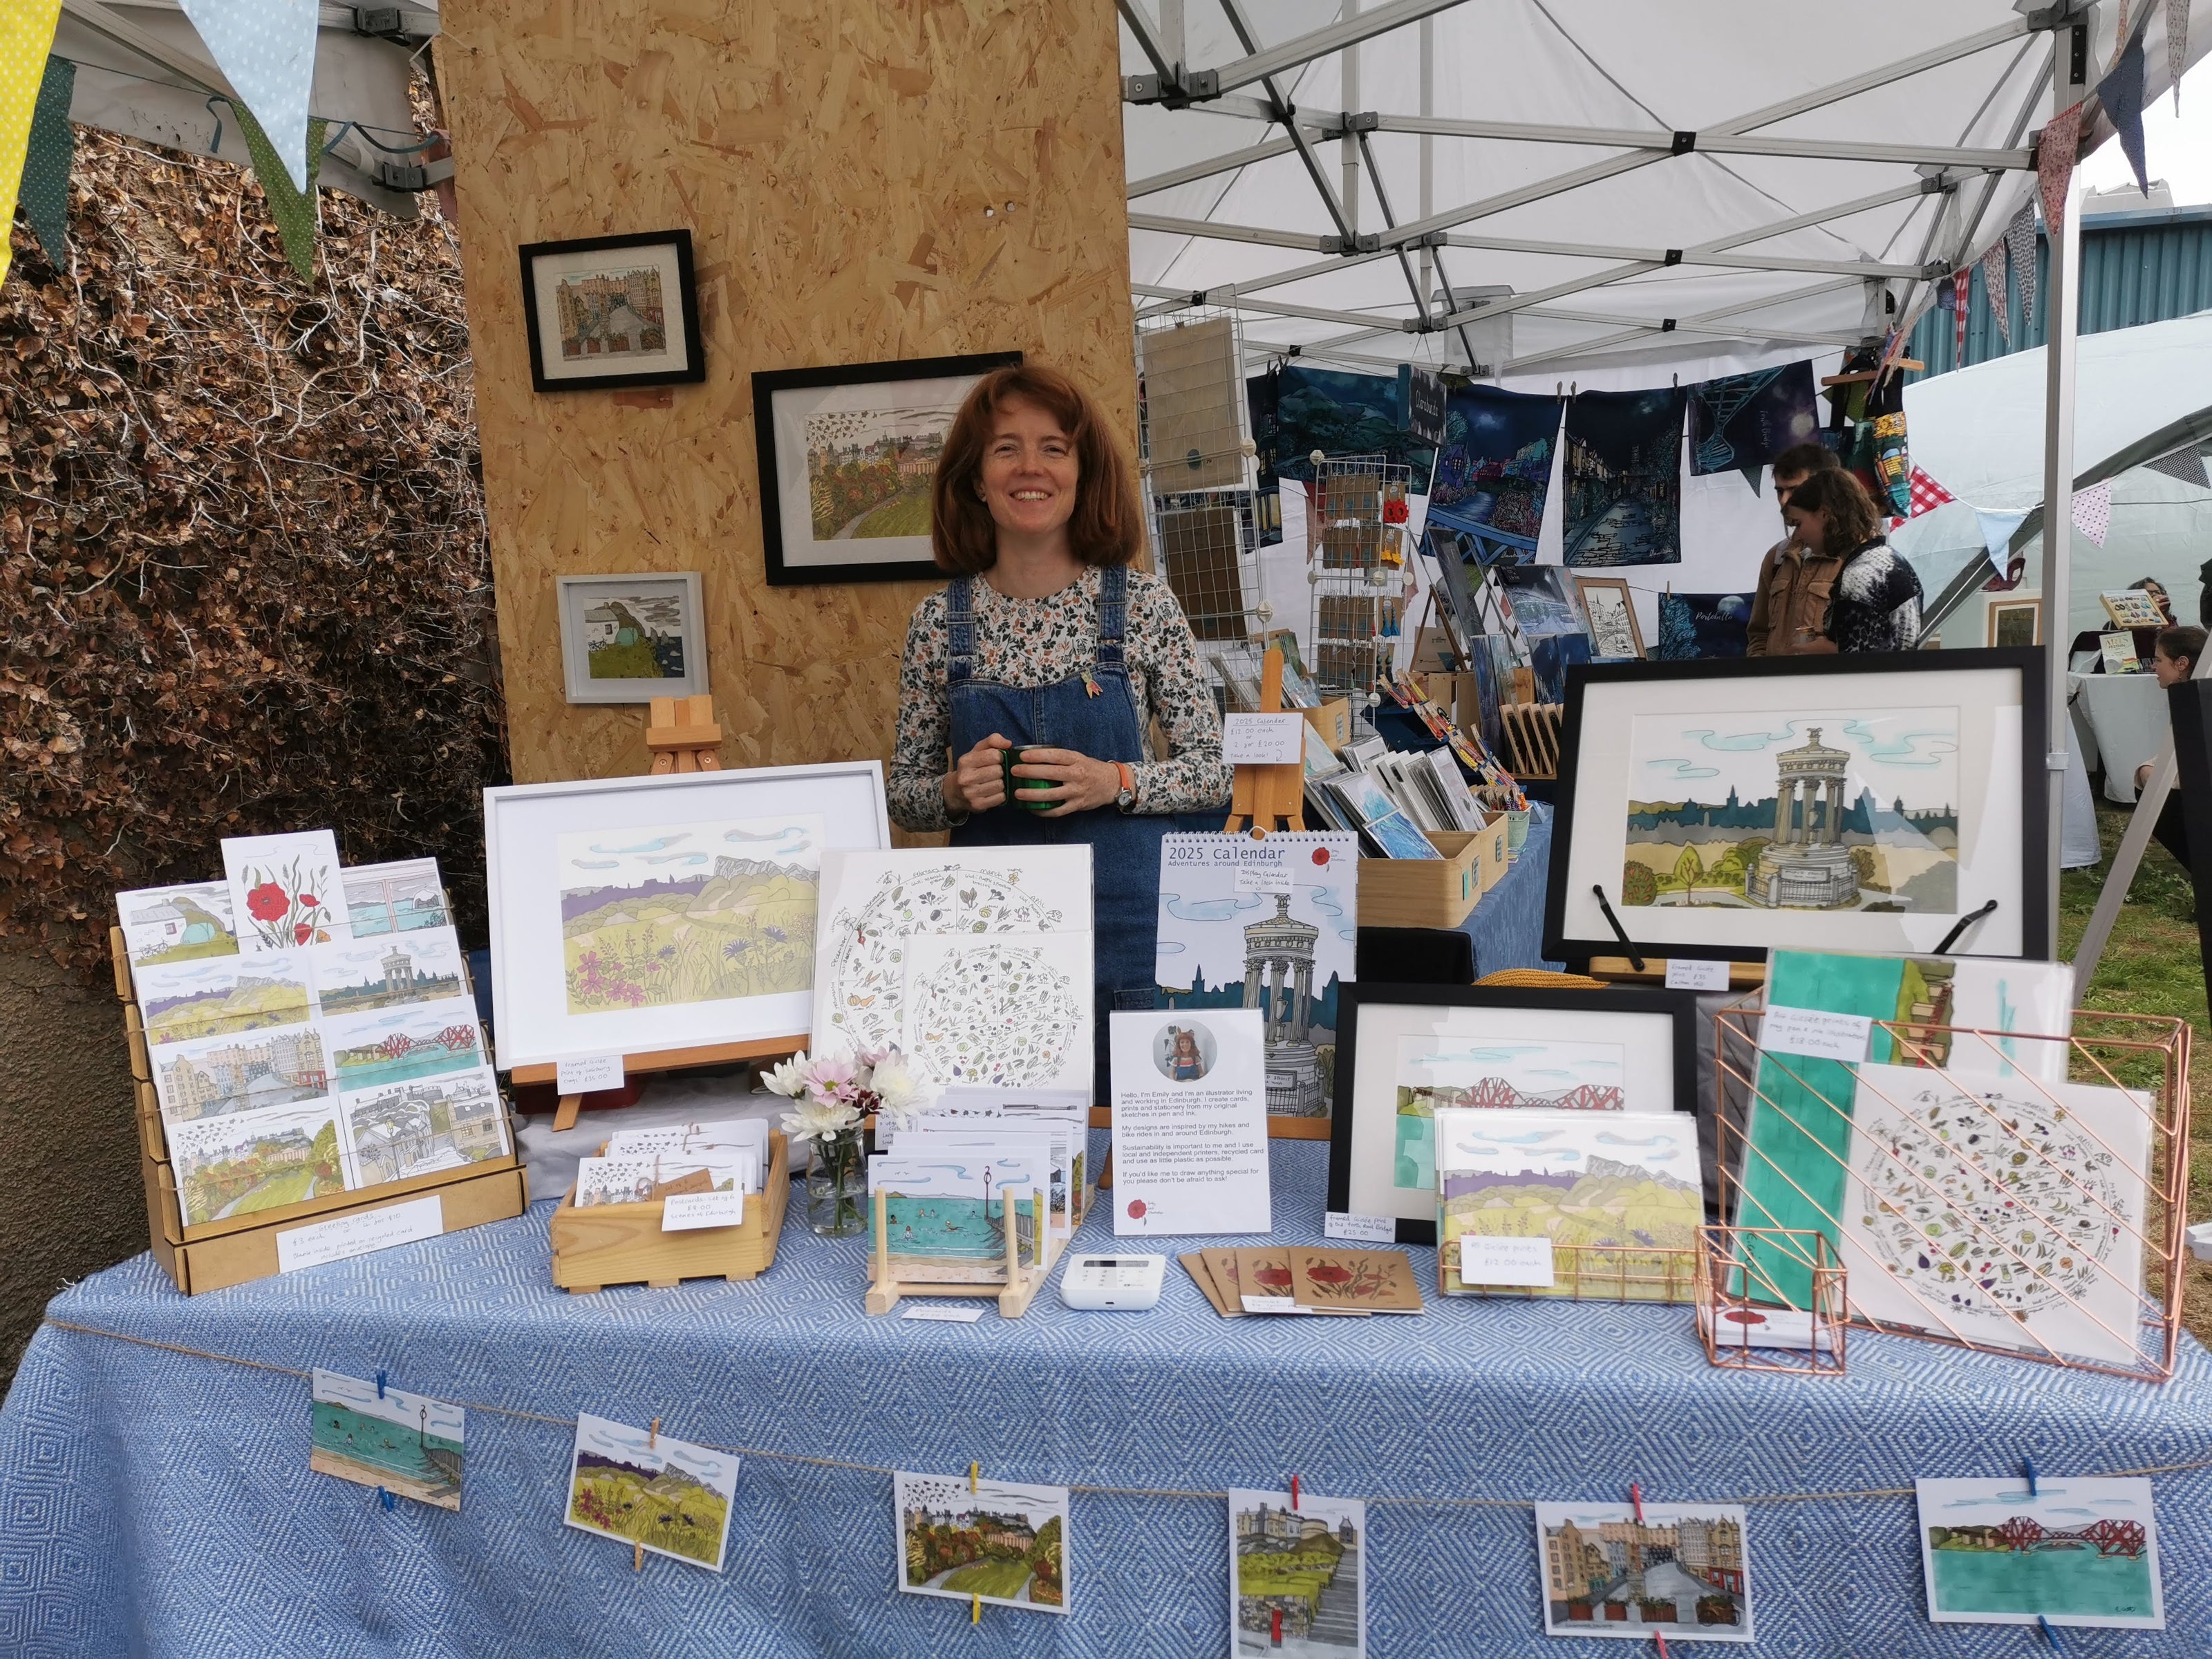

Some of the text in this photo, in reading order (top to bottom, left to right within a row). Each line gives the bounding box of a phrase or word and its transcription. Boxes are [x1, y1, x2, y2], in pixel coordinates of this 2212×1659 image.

[1695, 611, 1733, 621] Portobello
[1169, 846, 1285, 859] 2025 Calendar
[1152, 1150, 1192, 1158] independent
